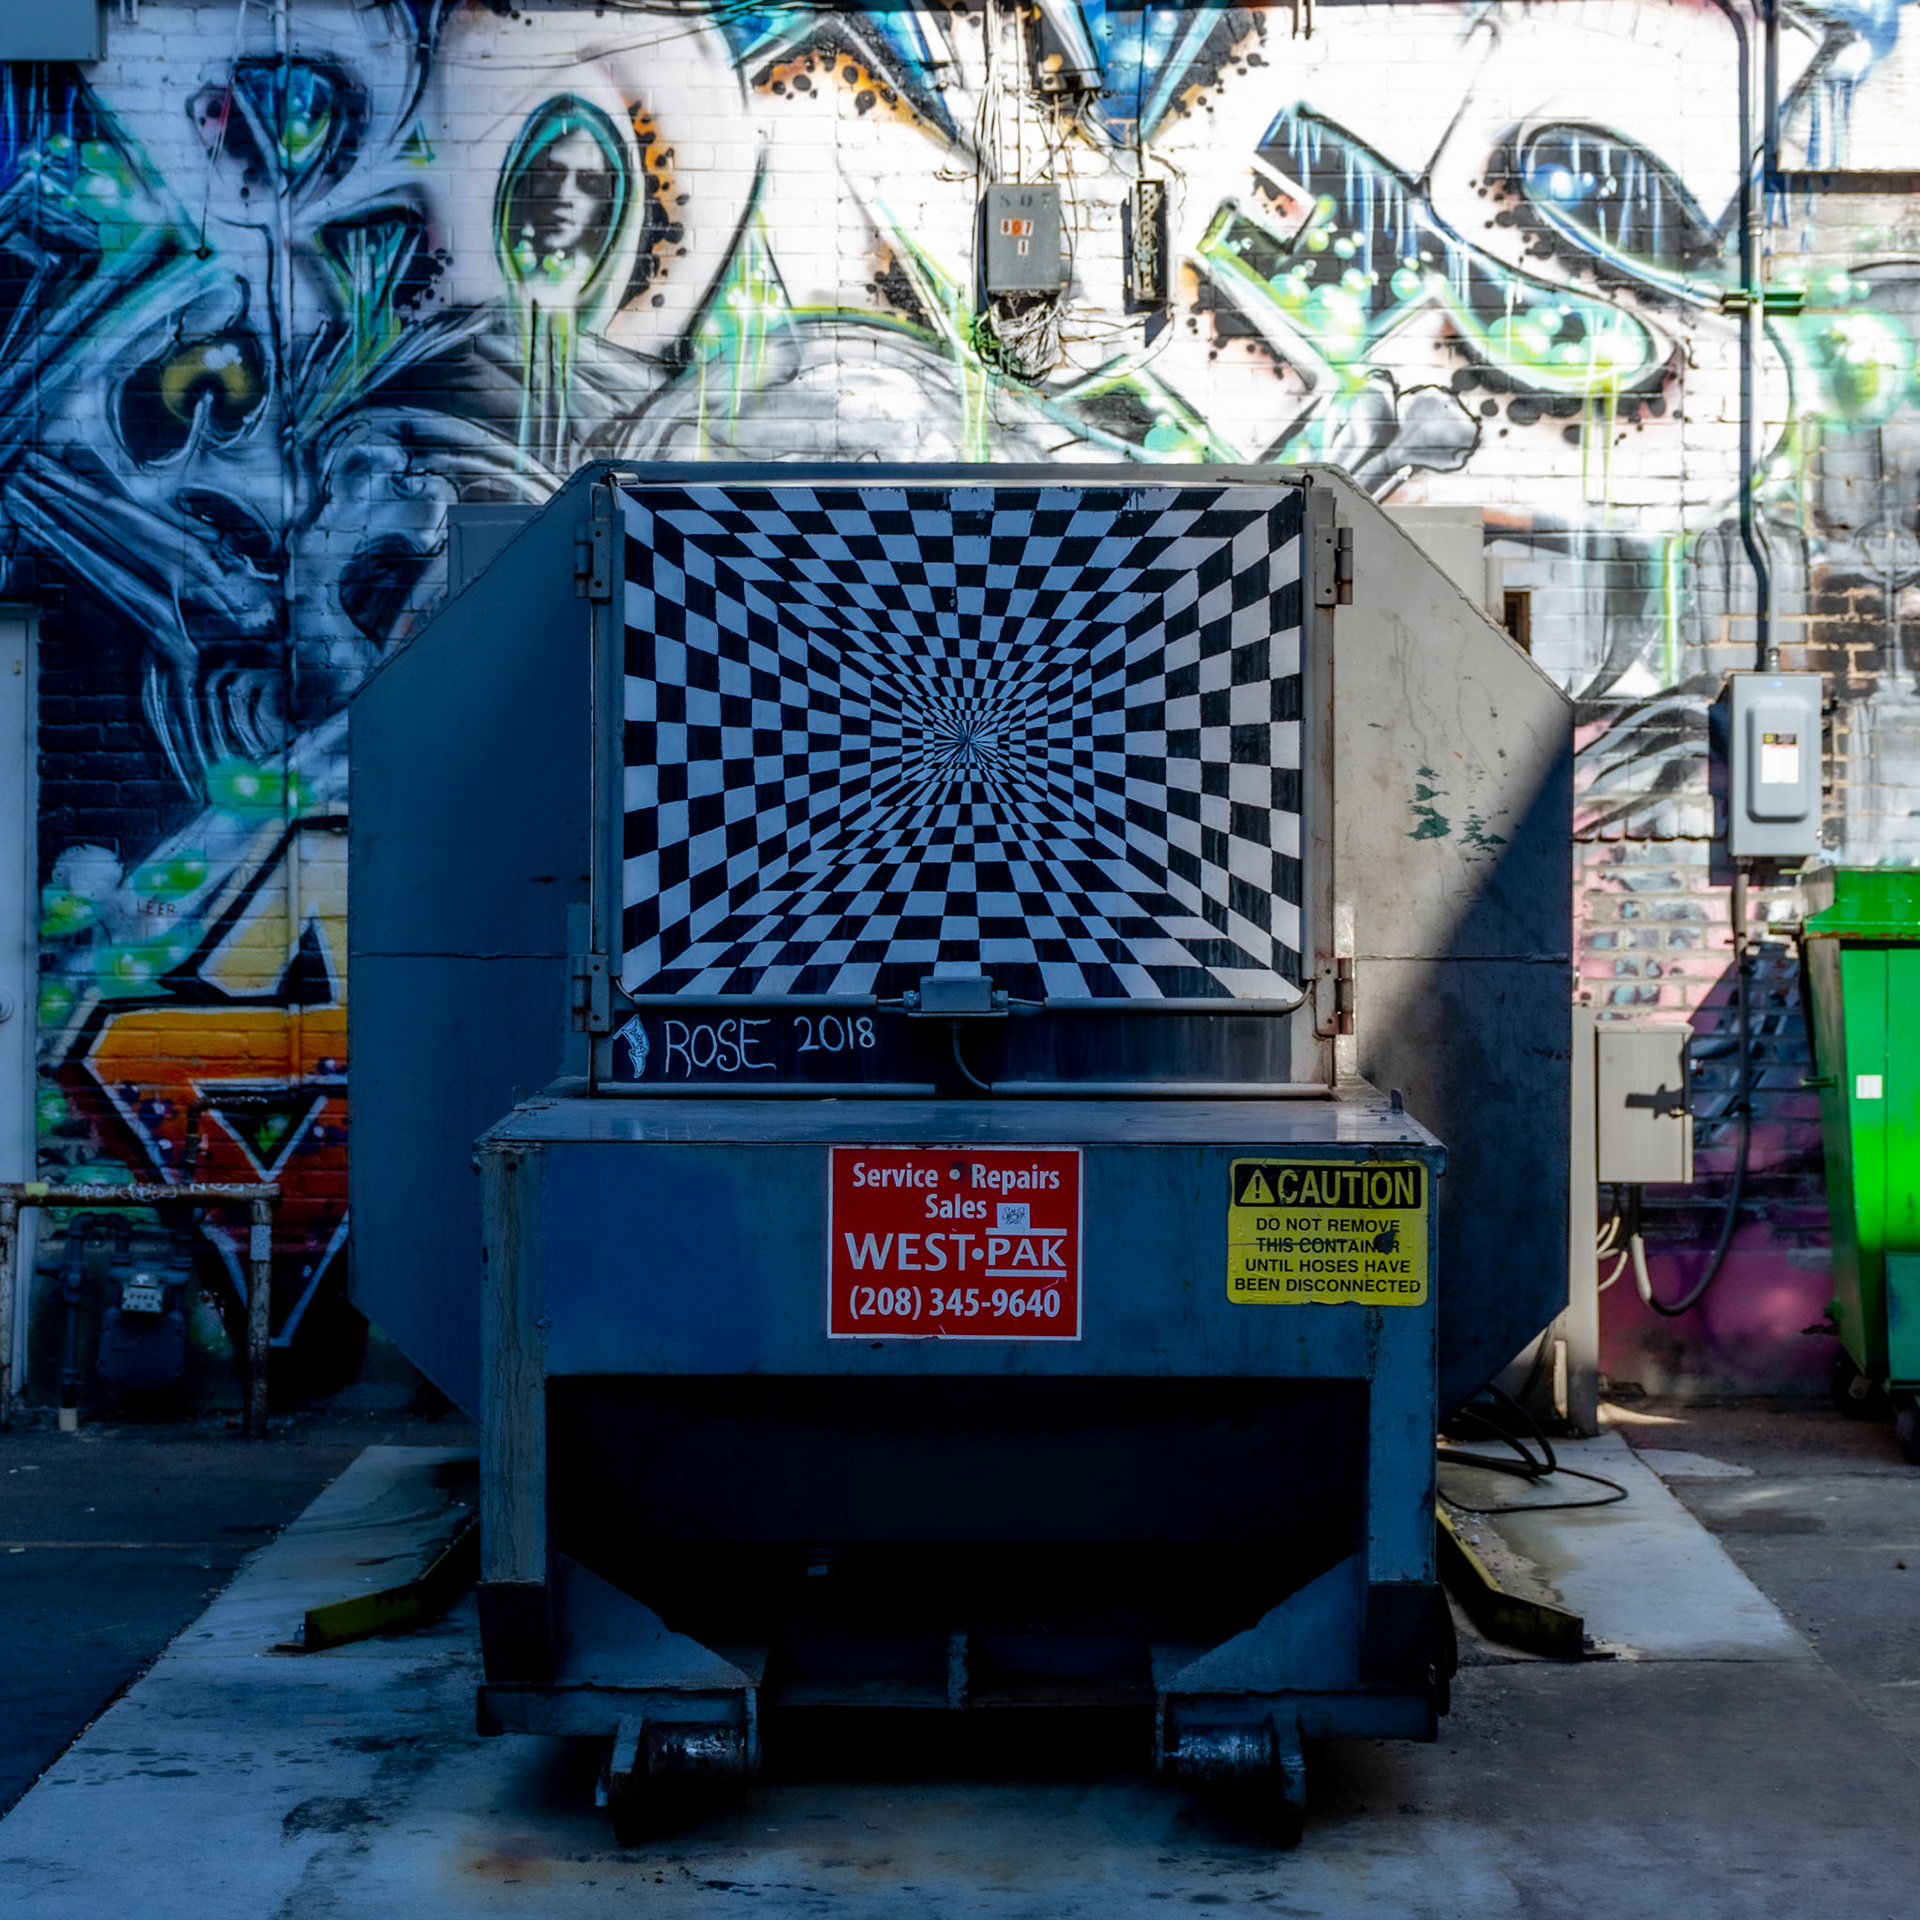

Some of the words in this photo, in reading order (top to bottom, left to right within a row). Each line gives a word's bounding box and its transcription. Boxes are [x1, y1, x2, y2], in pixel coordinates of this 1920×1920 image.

[1002, 220, 1032, 235] 807
[663, 1018, 777, 1078] ROSE
[793, 1014, 876, 1052] 2018
[852, 1162, 939, 1188] Service
[970, 1163, 1060, 1196] Repairs
[1277, 1168, 1415, 1206] CAUTION
[924, 1193, 988, 1219] Sales
[1256, 1217, 1281, 1231] DO
[1286, 1217, 1322, 1231] NOT
[1327, 1219, 1400, 1233] REMOVE
[1256, 1237, 1294, 1253] THIS
[1299, 1237, 1400, 1254] CONTAINR
[1245, 1258, 1294, 1272] UNTIL
[1299, 1259, 1359, 1273] HOSES
[1364, 1260, 1411, 1273] HAVE
[1235, 1278, 1280, 1291] BEEN
[1286, 1278, 1421, 1293] DISCONNECTED
[850, 1285, 922, 1321] (208)
[928, 1288, 1061, 1318] 345-9640
